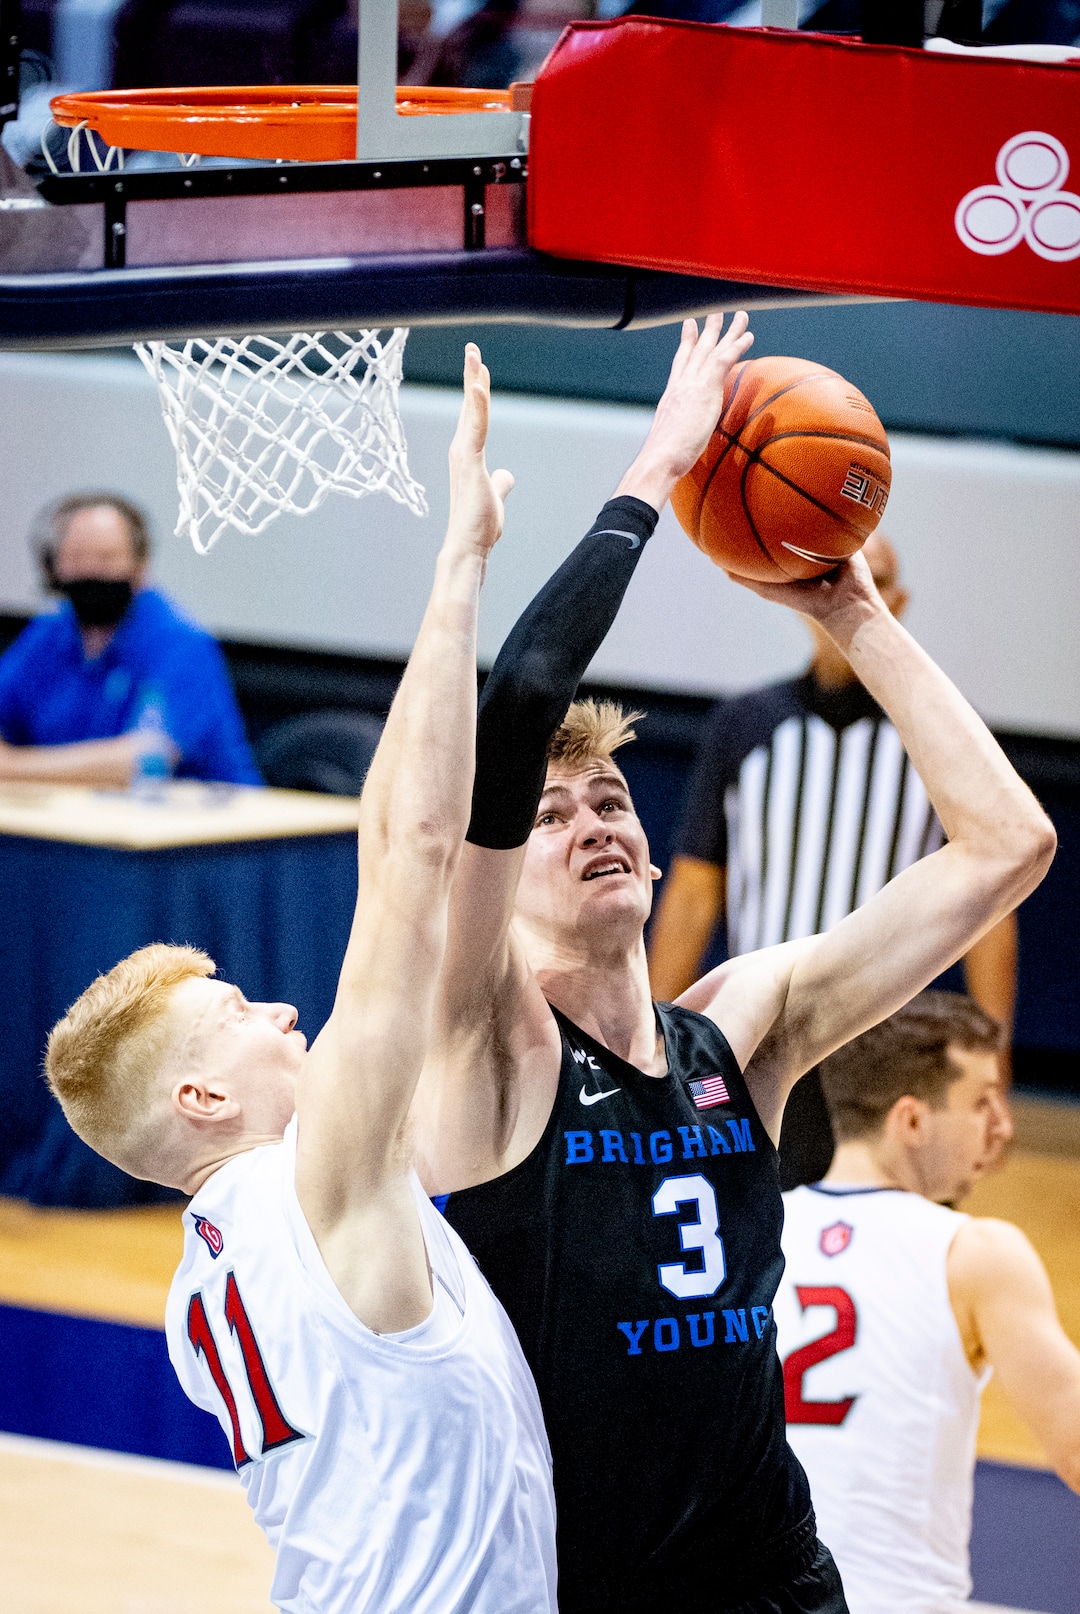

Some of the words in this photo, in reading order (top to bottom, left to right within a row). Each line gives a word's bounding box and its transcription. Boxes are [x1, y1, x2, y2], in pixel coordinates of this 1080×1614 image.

[564, 1118, 756, 1166] BRIGHAM
[651, 1172, 727, 1300] 3
[186, 1267, 310, 1472] 11
[617, 1305, 768, 1356] YOUNG
[782, 1284, 858, 1426] 2
